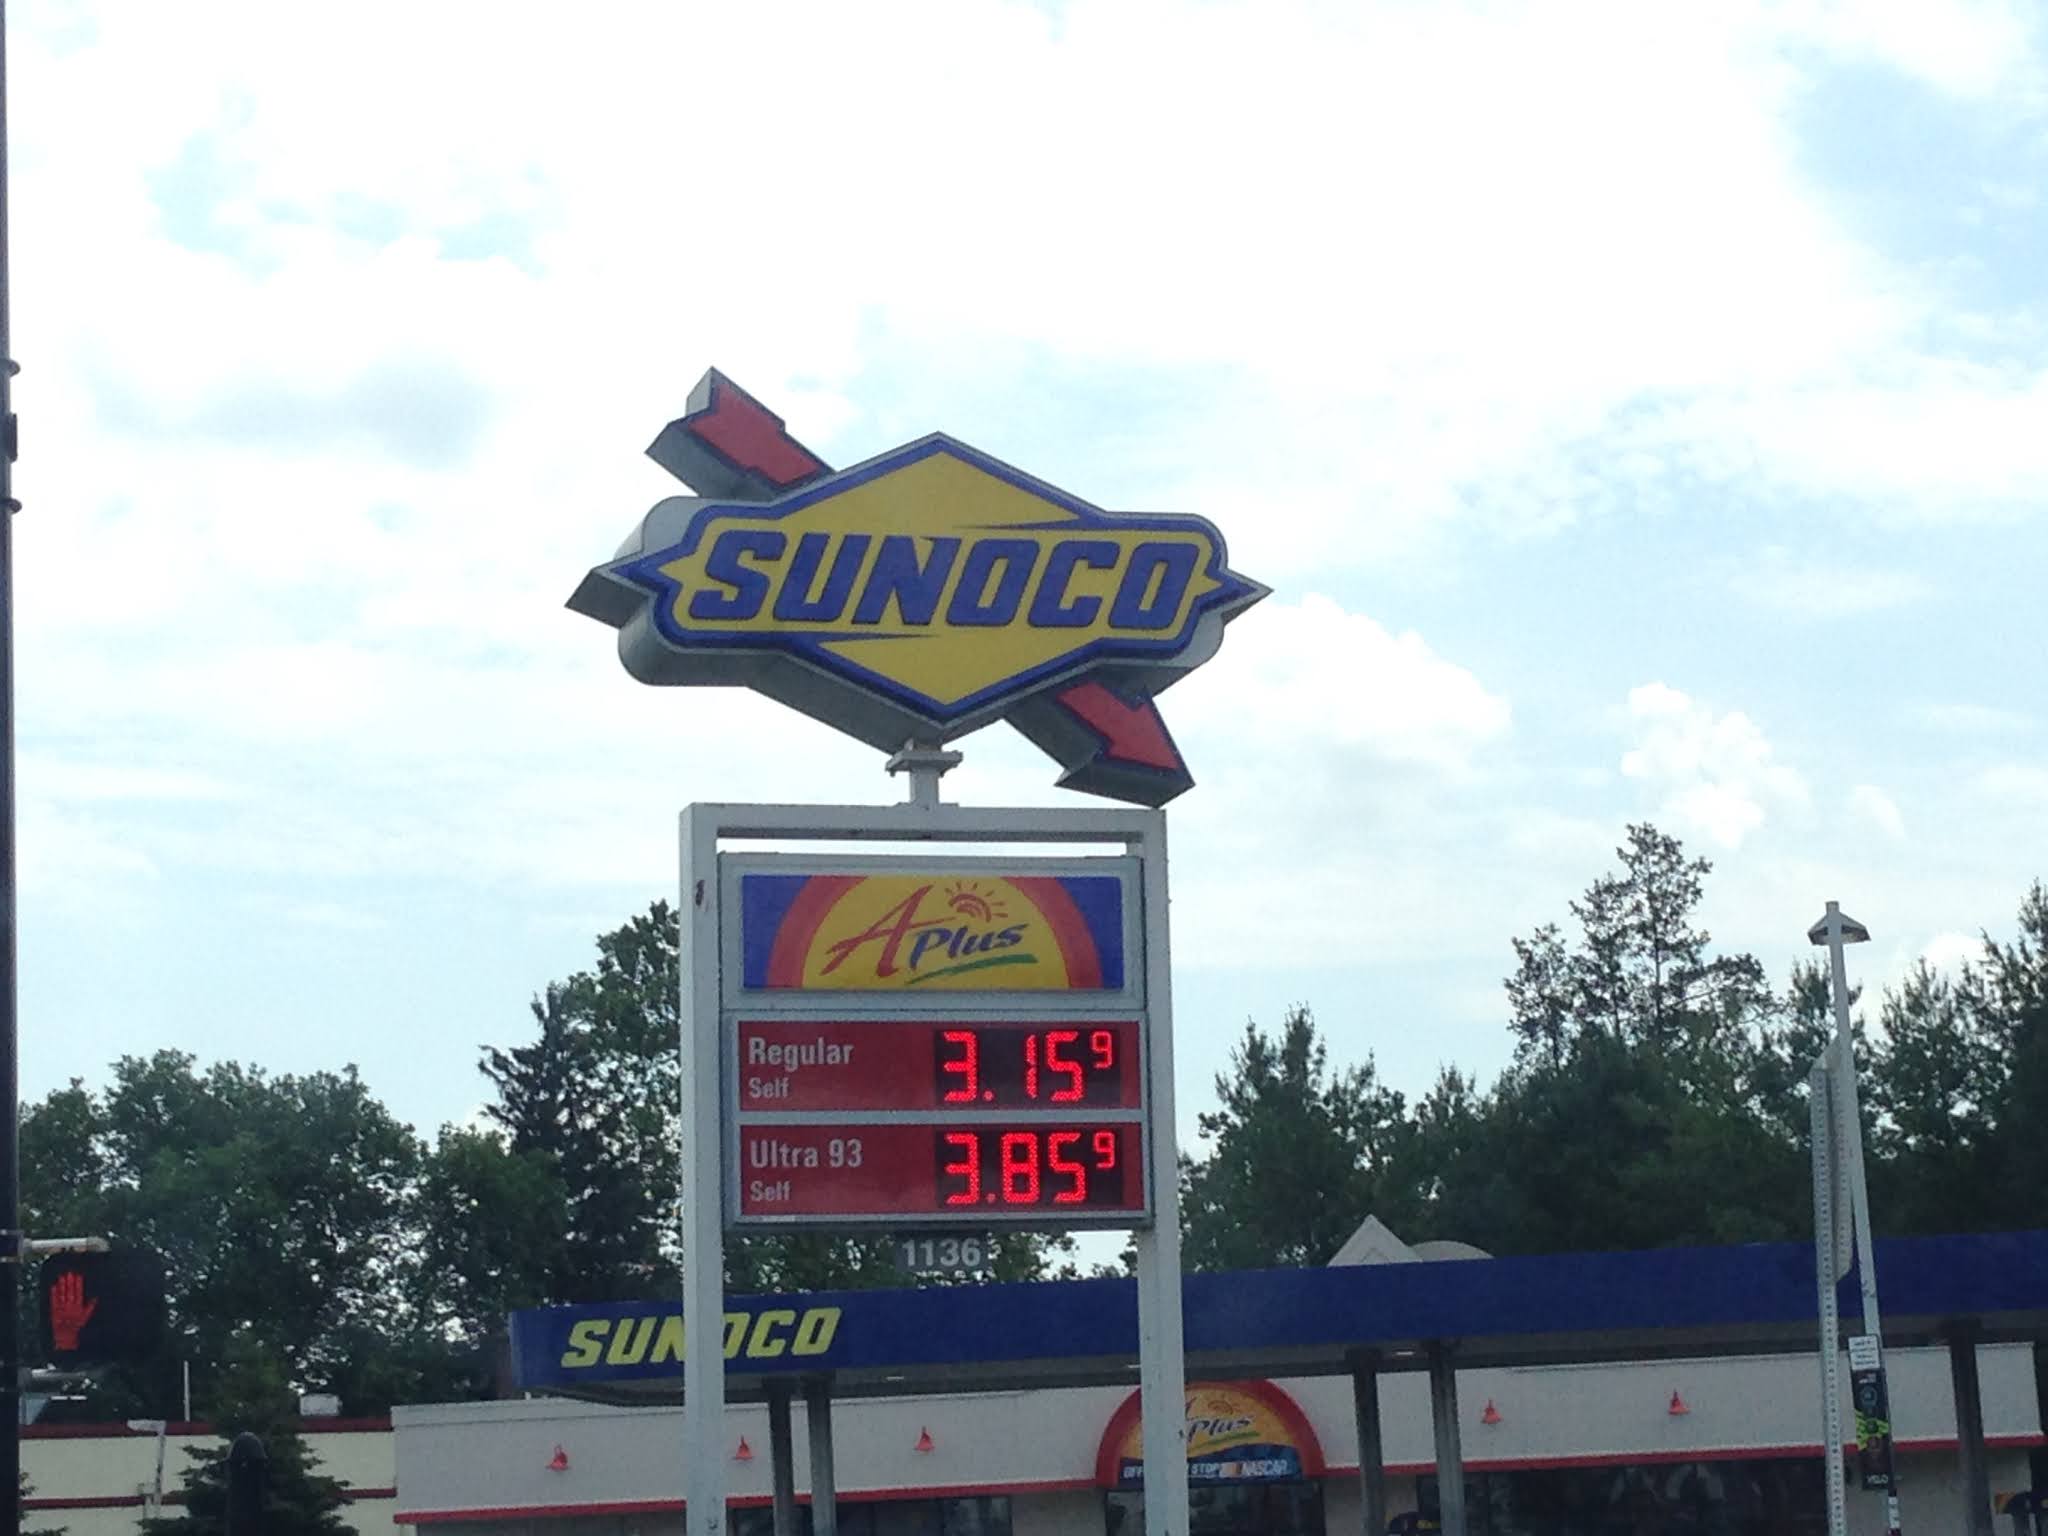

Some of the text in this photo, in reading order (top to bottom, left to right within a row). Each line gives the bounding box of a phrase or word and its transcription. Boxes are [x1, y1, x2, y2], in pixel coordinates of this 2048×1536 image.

[689, 529, 1201, 631] SUNOCO
[748, 1036, 855, 1073] Regular
[748, 1077, 790, 1100] Self
[750, 1140, 819, 1169] Ultra
[828, 1139, 863, 1169] 93
[750, 1180, 792, 1203] Self
[901, 1237, 983, 1268] 1136
[1241, 1459, 1288, 1476] NASCAR
